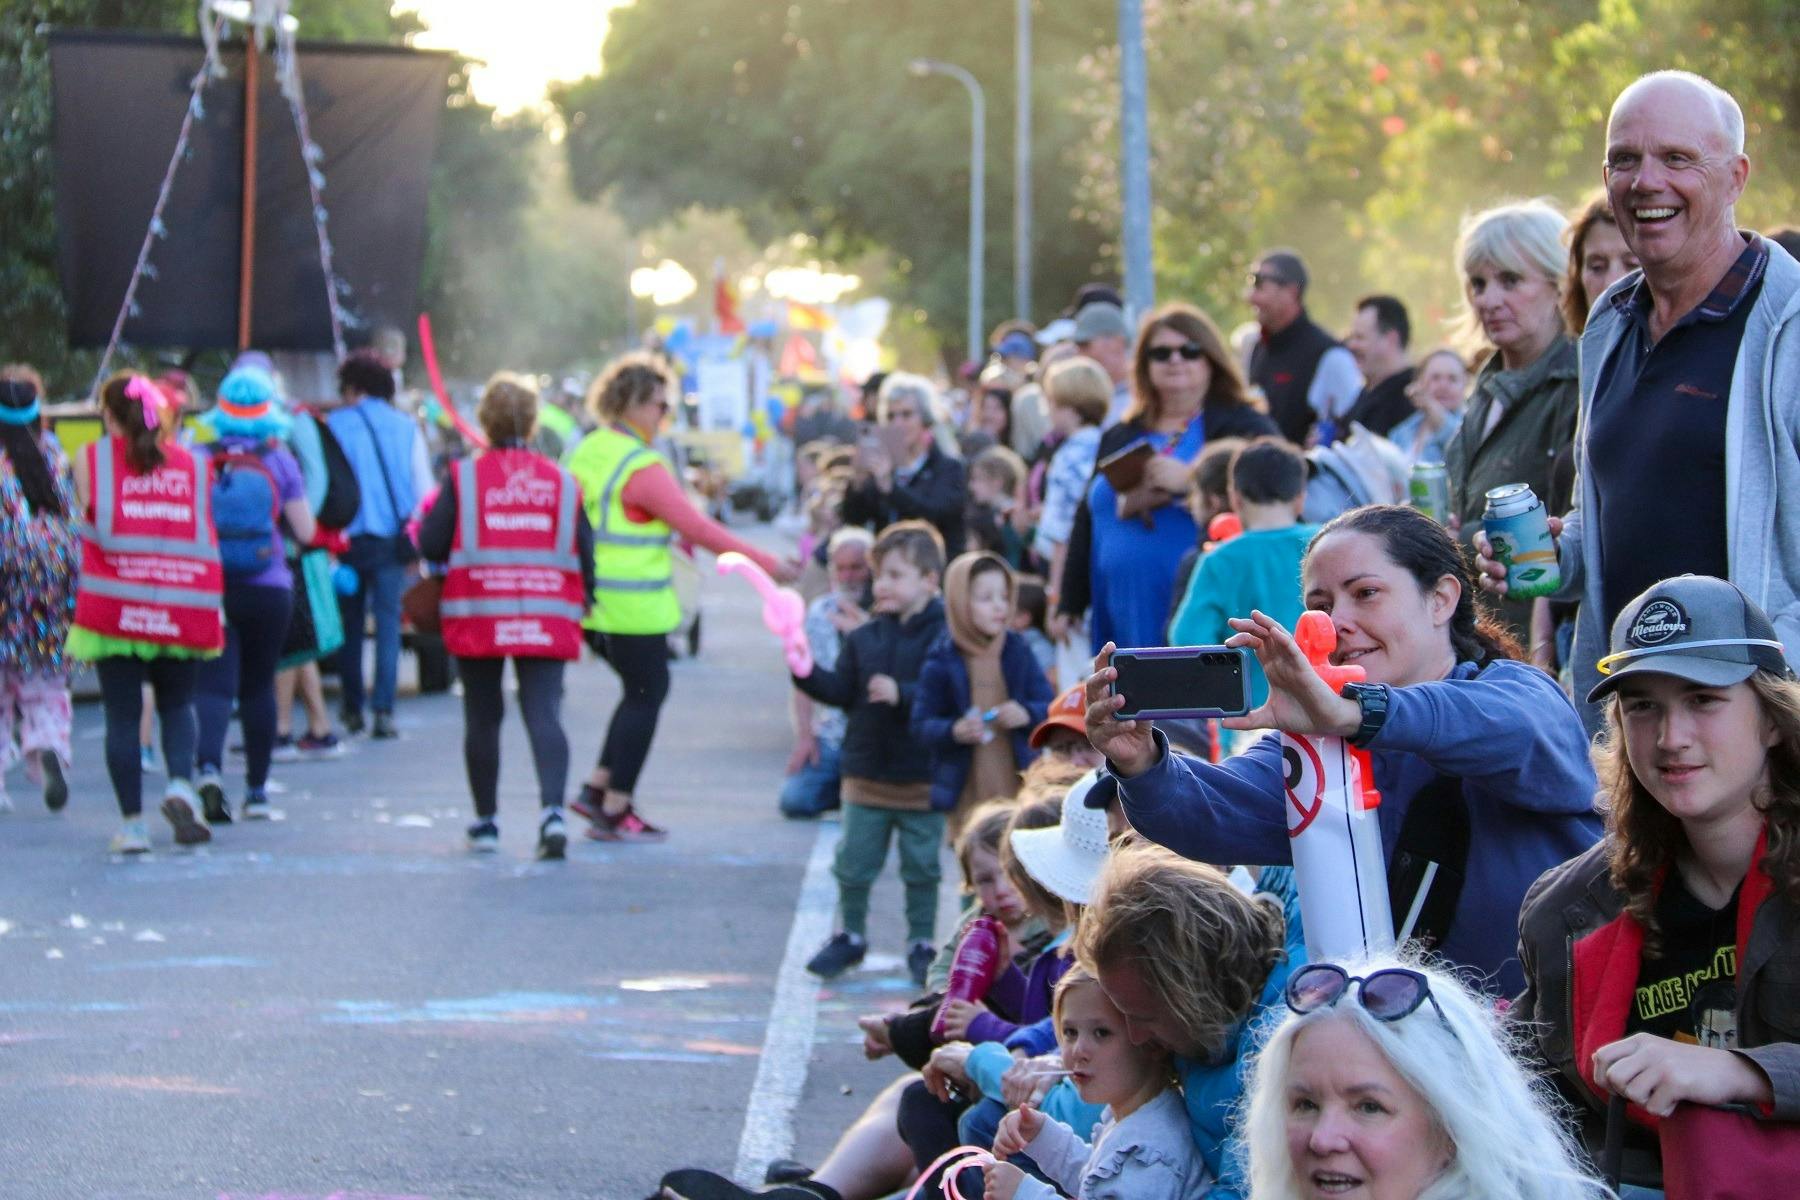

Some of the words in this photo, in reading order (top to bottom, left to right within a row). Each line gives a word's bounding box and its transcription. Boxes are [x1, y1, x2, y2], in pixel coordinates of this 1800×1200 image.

[121, 501, 192, 521] VOLUNTEER
[485, 513, 552, 531] VOLUNTEER
[1631, 620, 1686, 638] Meadows
[1636, 976, 1688, 1020] RAGE
